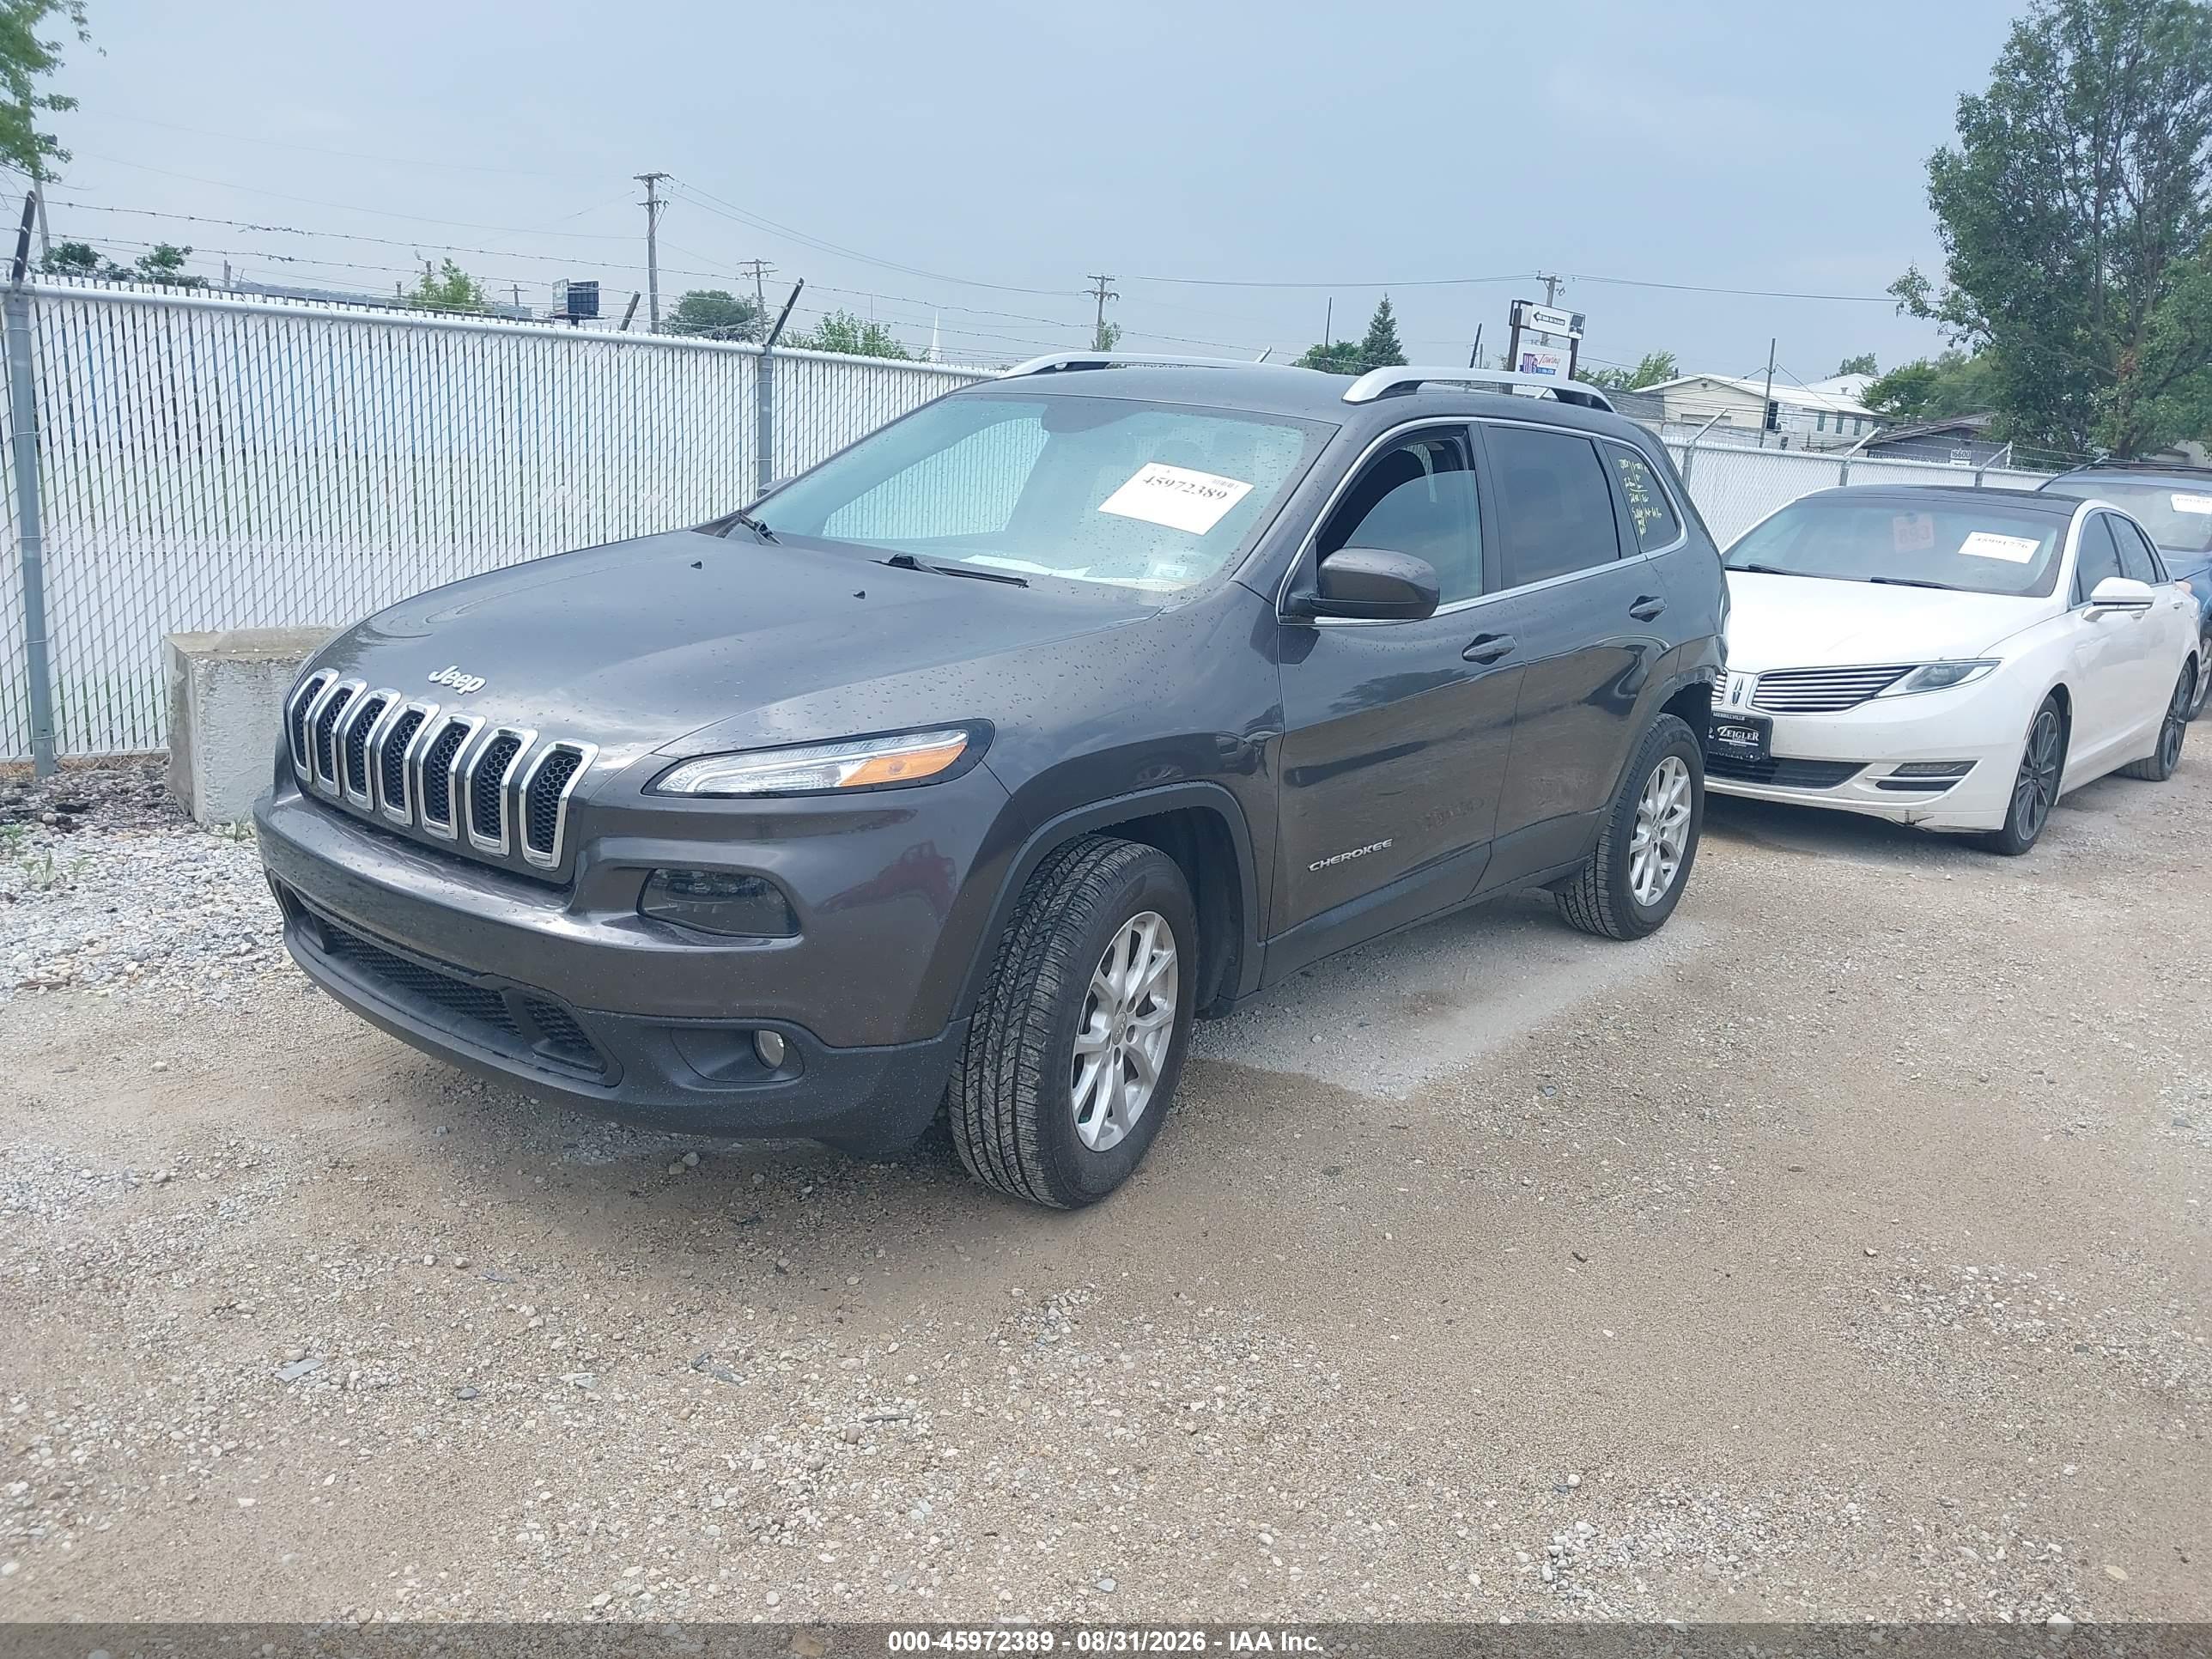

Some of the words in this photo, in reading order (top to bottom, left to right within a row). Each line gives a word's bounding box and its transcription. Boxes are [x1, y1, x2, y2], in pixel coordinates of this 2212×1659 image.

[1143, 476, 1227, 500] 45972389
[428, 665, 487, 695] Jeep
[1720, 728, 1759, 741] ZEIGLER
[1309, 838, 1393, 872] CHEROKEE
